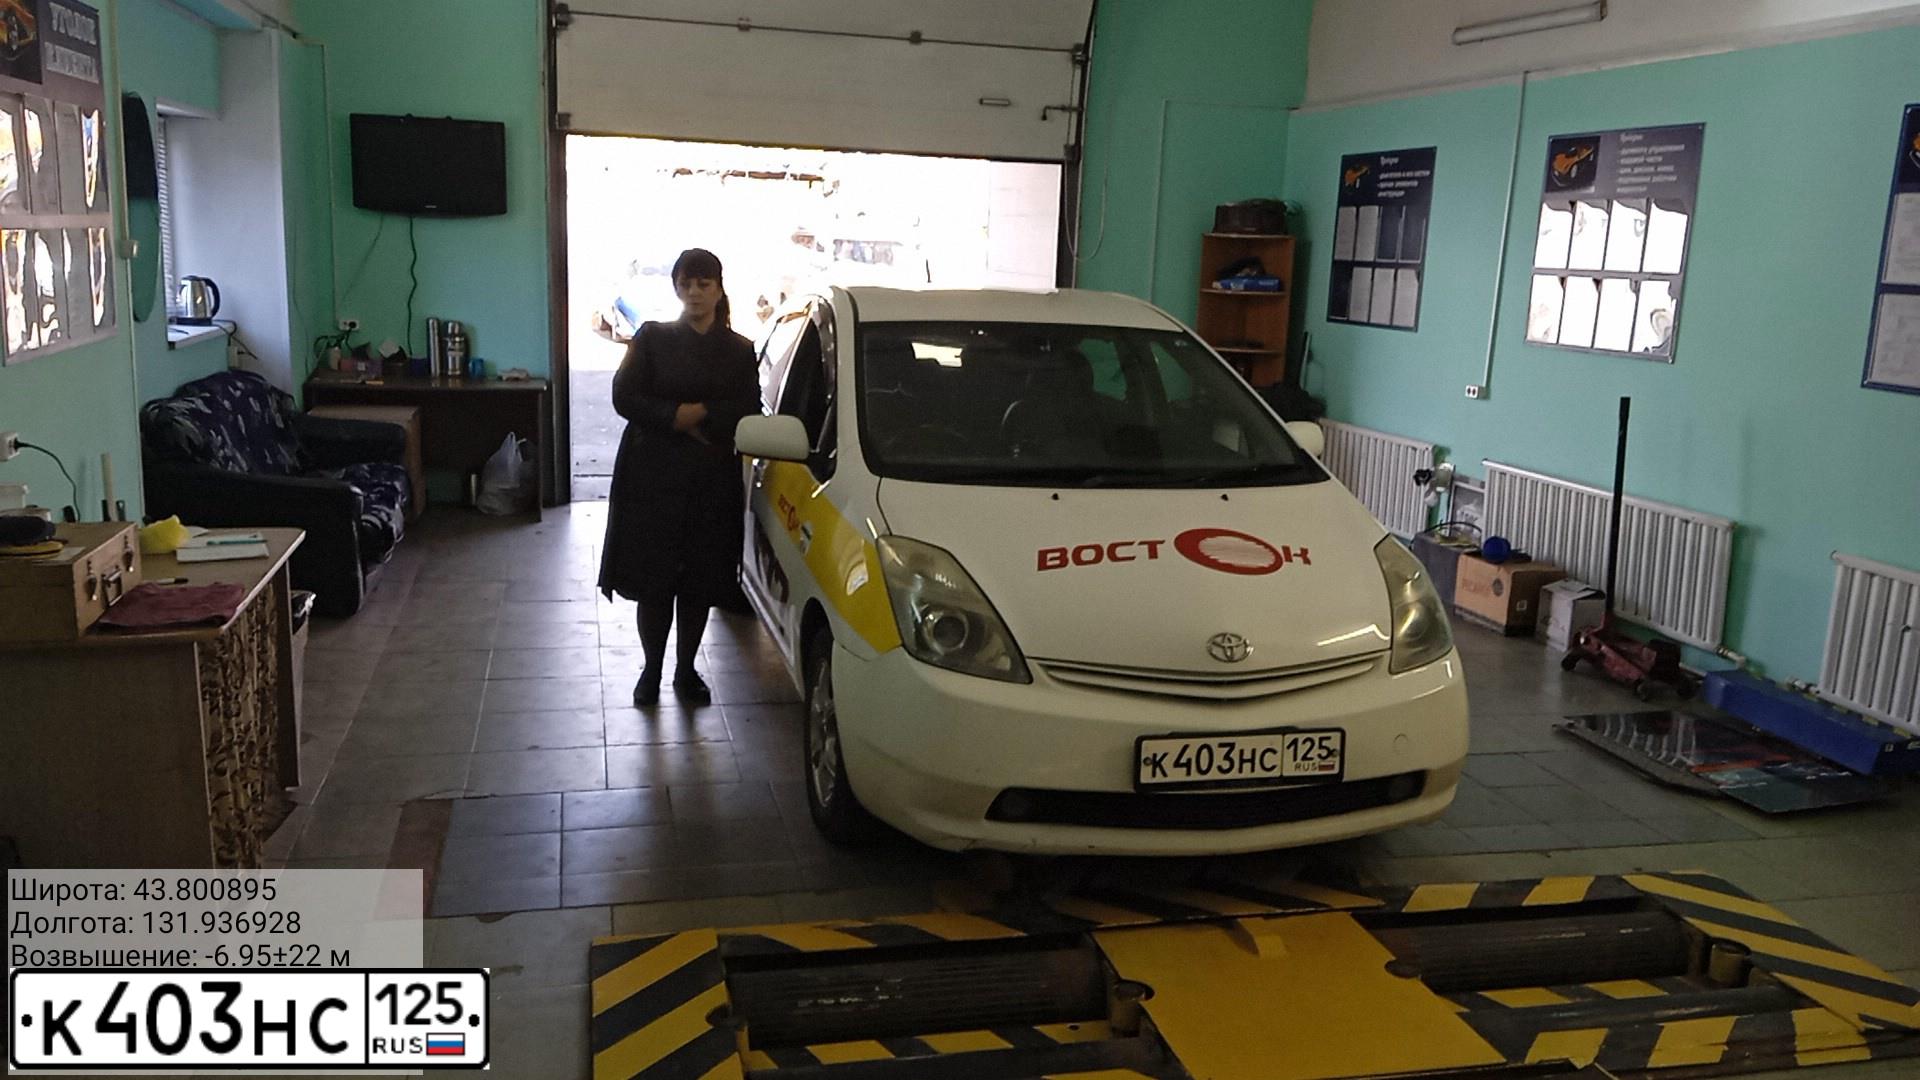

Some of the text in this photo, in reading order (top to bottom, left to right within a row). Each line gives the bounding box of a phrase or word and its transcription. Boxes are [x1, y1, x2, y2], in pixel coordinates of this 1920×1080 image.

[1151, 736, 1334, 778] К403НС 125
[1294, 762, 1318, 772] RUS
